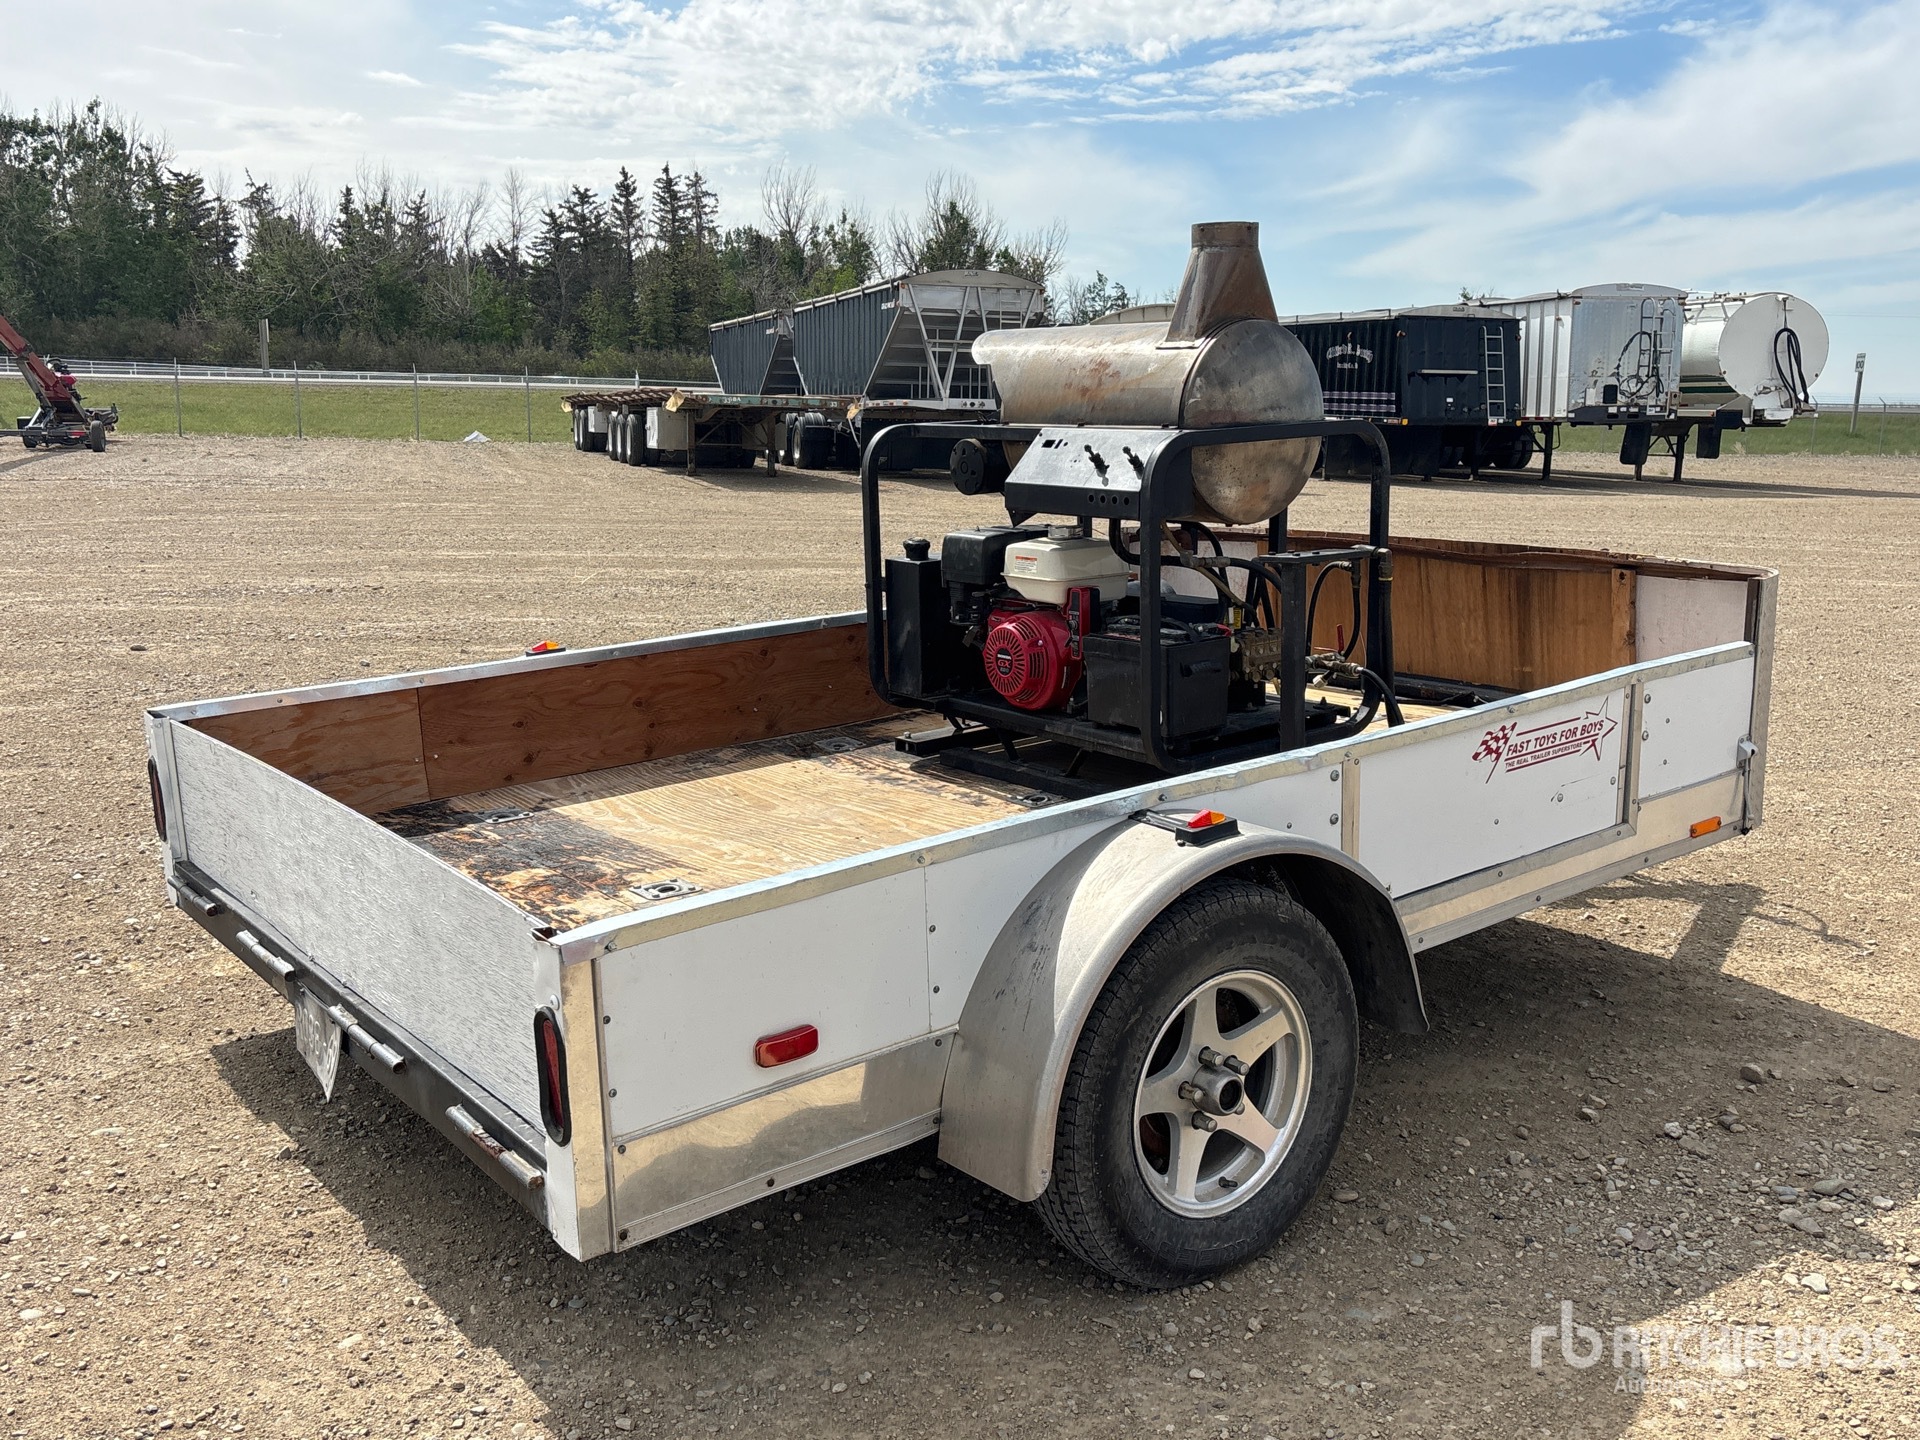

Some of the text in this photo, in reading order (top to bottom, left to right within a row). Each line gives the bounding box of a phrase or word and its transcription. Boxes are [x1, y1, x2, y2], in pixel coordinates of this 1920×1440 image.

[998, 659, 1011, 669] GX
[1506, 719, 1605, 757] FAST TOYS FOR BOYS
[1505, 742, 1583, 769] THE REAL TRAILER SUPERSTORE
